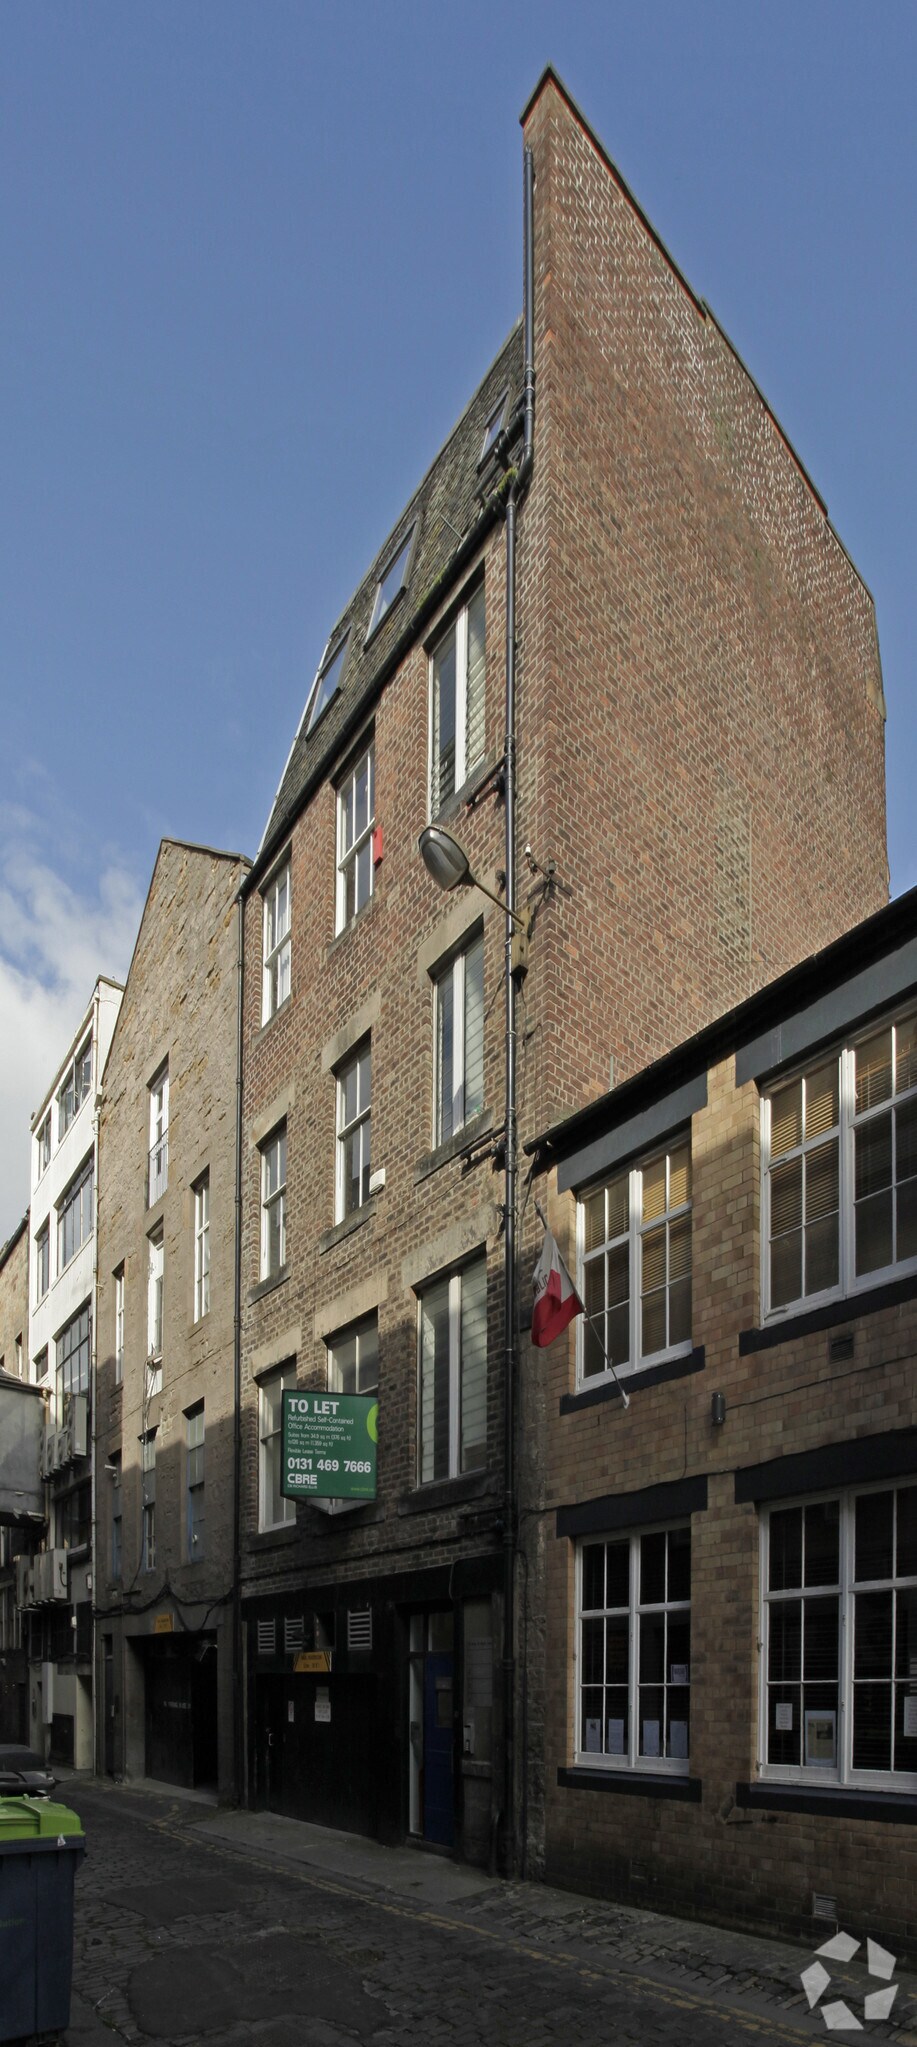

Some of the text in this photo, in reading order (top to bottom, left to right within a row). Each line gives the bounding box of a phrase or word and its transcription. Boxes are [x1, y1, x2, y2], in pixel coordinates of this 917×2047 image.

[288, 1398, 340, 1414] TO LET
[288, 1414, 316, 1422] Refurbished
[304, 1424, 344, 1432] Accommodation
[287, 1457, 371, 1473] 0131 469 7666
[287, 1473, 318, 1484] CBRE
